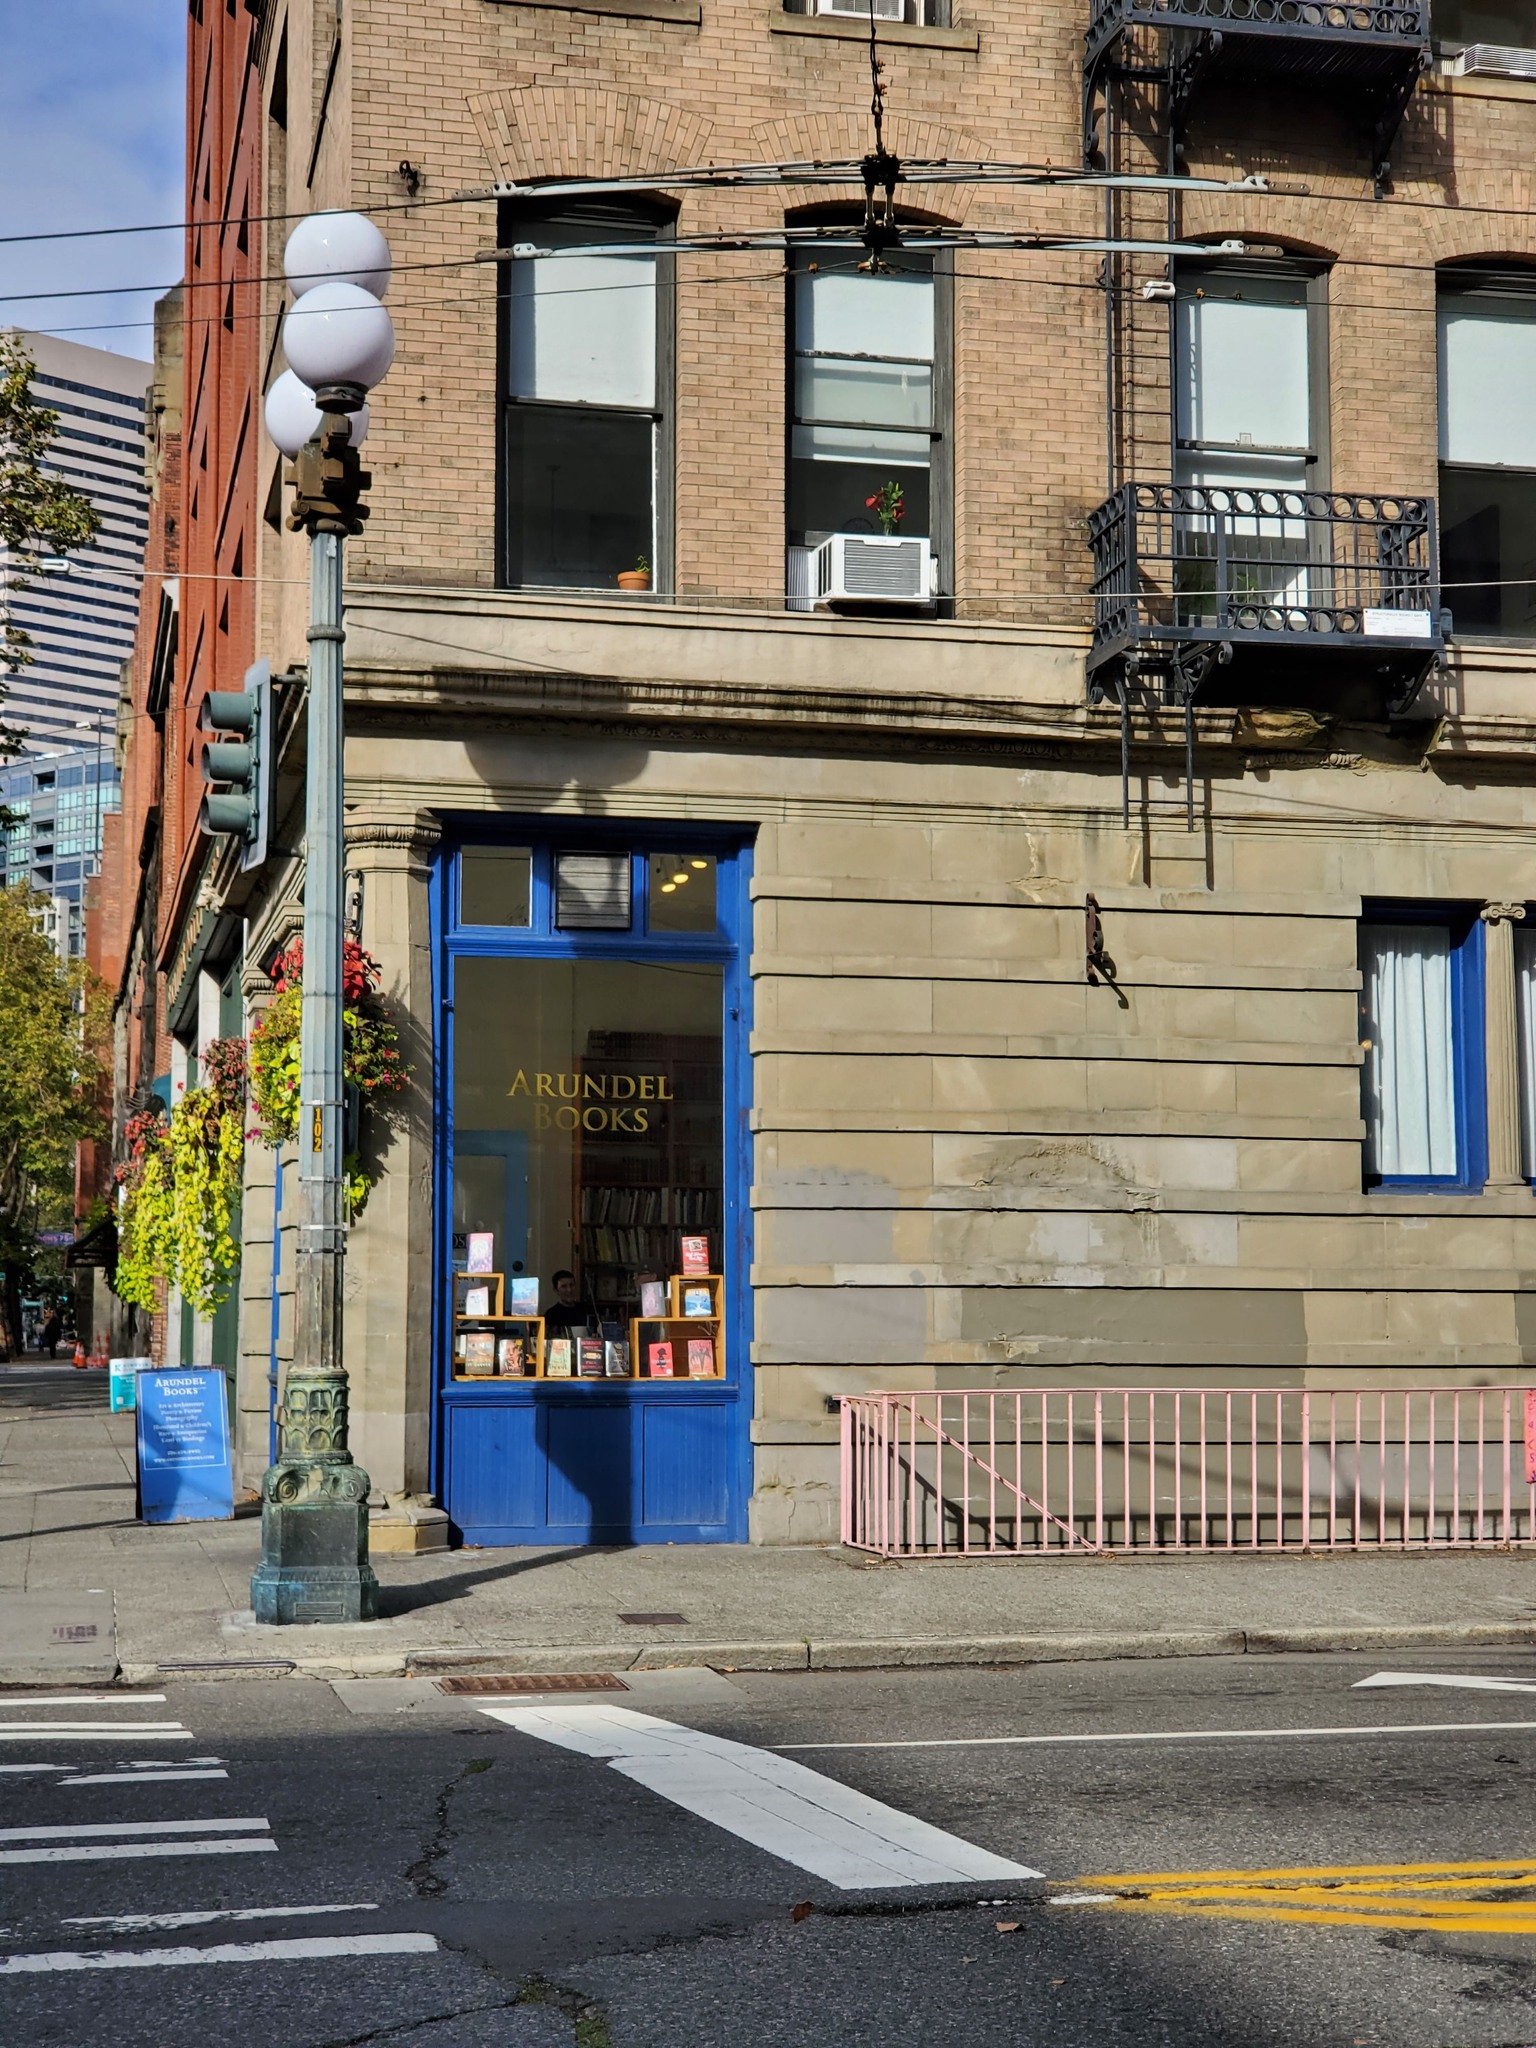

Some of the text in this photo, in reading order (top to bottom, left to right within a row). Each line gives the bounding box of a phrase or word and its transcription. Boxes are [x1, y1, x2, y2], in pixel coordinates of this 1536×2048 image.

[507, 1069, 673, 1100] ARUNDEL
[314, 1107, 322, 1152] 102
[534, 1103, 648, 1132] BOOKS
[155, 1378, 206, 1388] ARUNDEL
[163, 1387, 198, 1396] BOOKS
